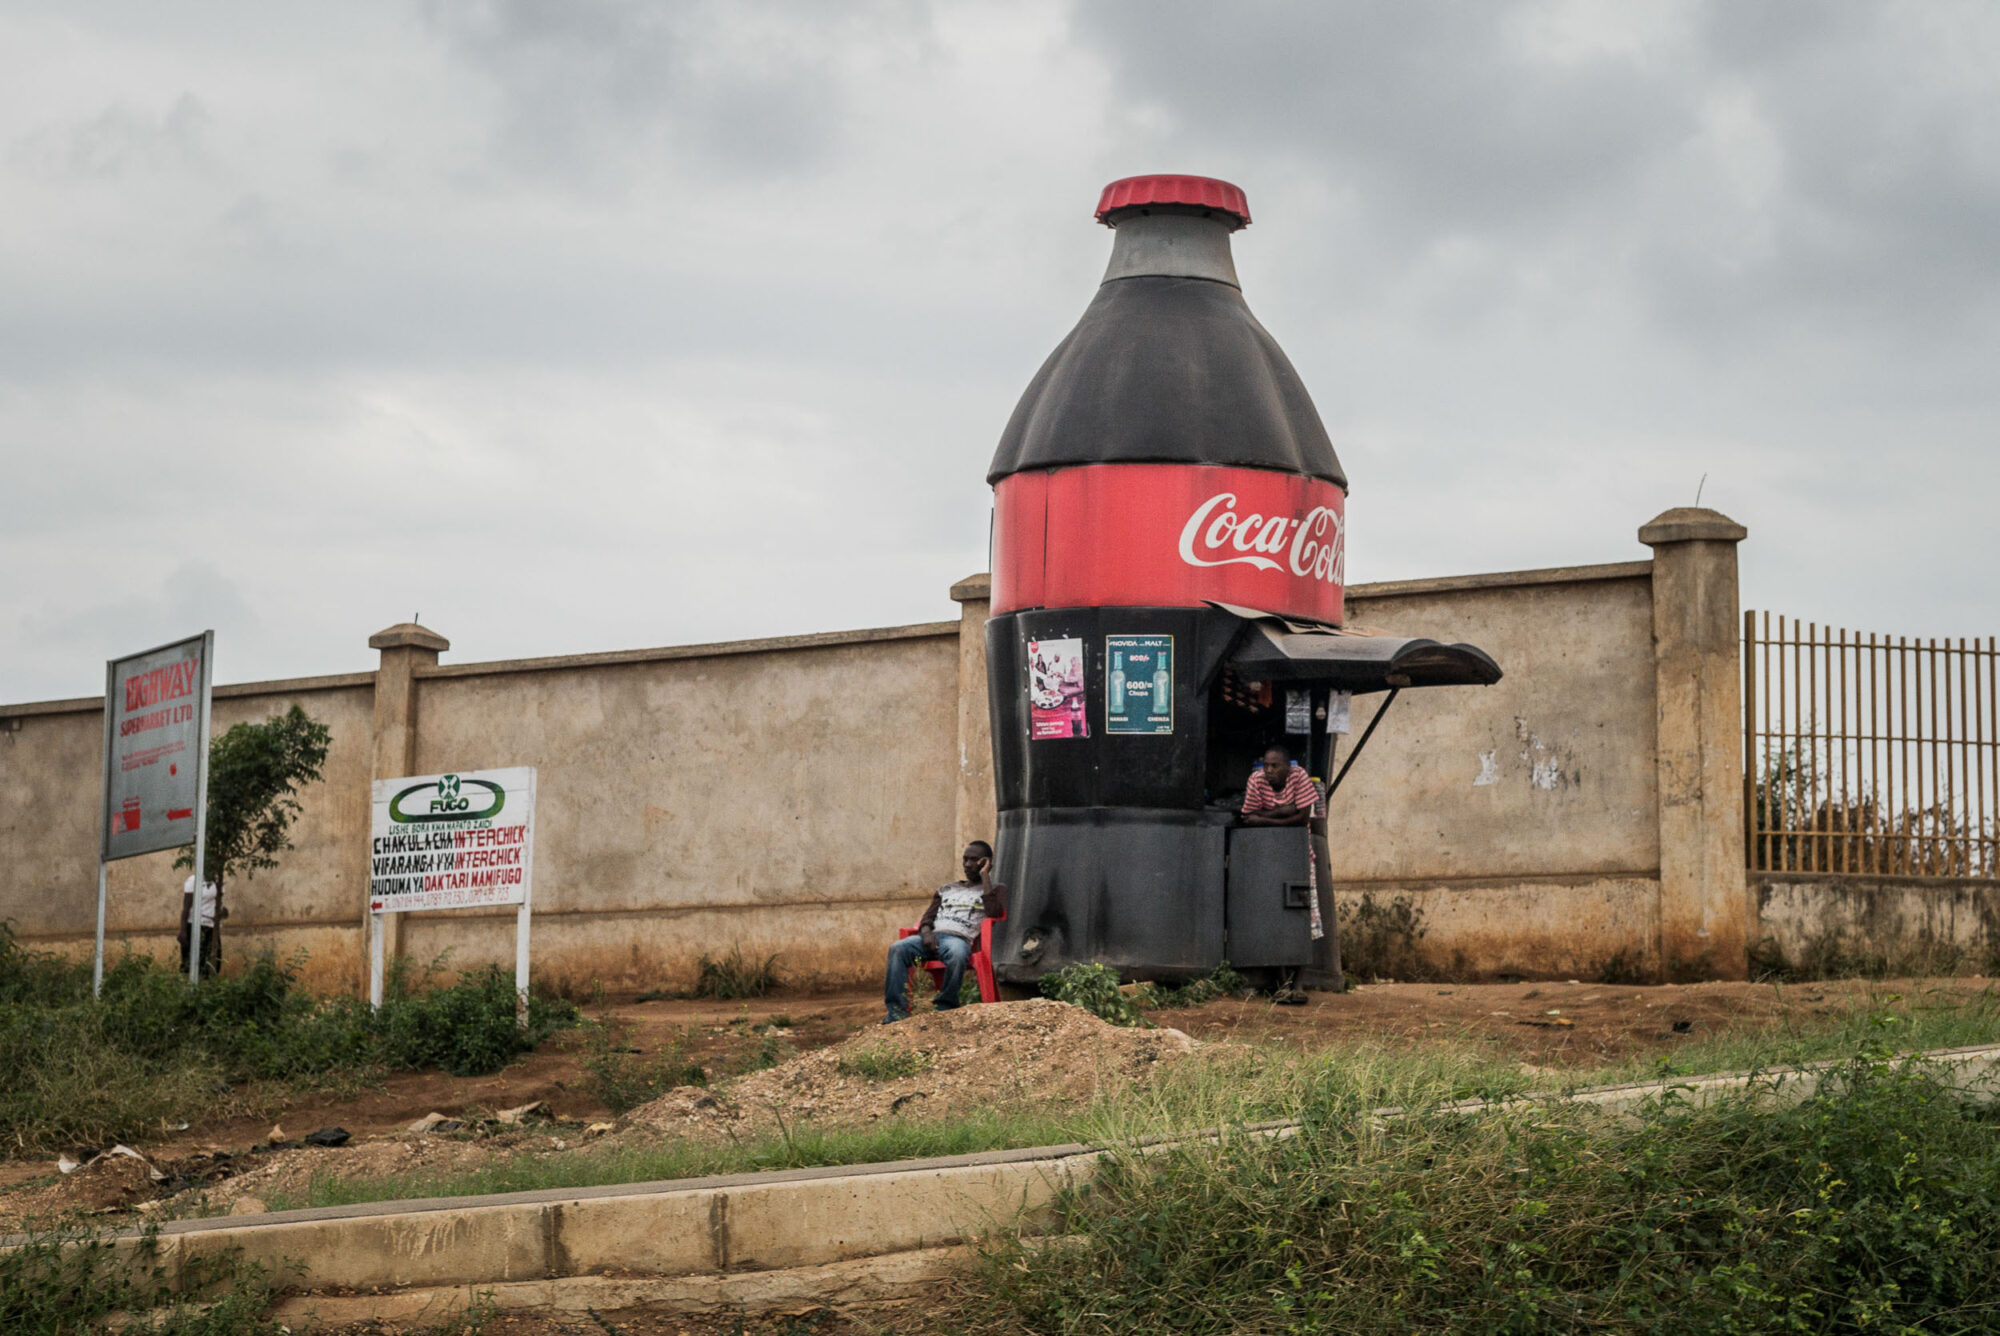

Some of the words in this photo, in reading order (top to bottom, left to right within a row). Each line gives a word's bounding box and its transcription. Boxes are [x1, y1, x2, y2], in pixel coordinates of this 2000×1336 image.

[125, 658, 199, 713] HIGHWAY
[173, 704, 193, 724] LTD
[430, 797, 470, 813] FUGO
[373, 834, 431, 855] CHAKULA
[432, 831, 453, 850] CHA
[454, 826, 526, 848] INTERCHICK
[389, 825, 409, 836] LISHE
[411, 822, 430, 834] BORA
[372, 853, 433, 876] VIFARANGA
[436, 852, 455, 871] VYA
[454, 848, 522, 869] INTERCHICK
[371, 877, 411, 896] HUDUMA
[412, 876, 424, 893] YA
[424, 872, 469, 892] DAKTARI
[471, 867, 522, 887] WAMIFUGO
